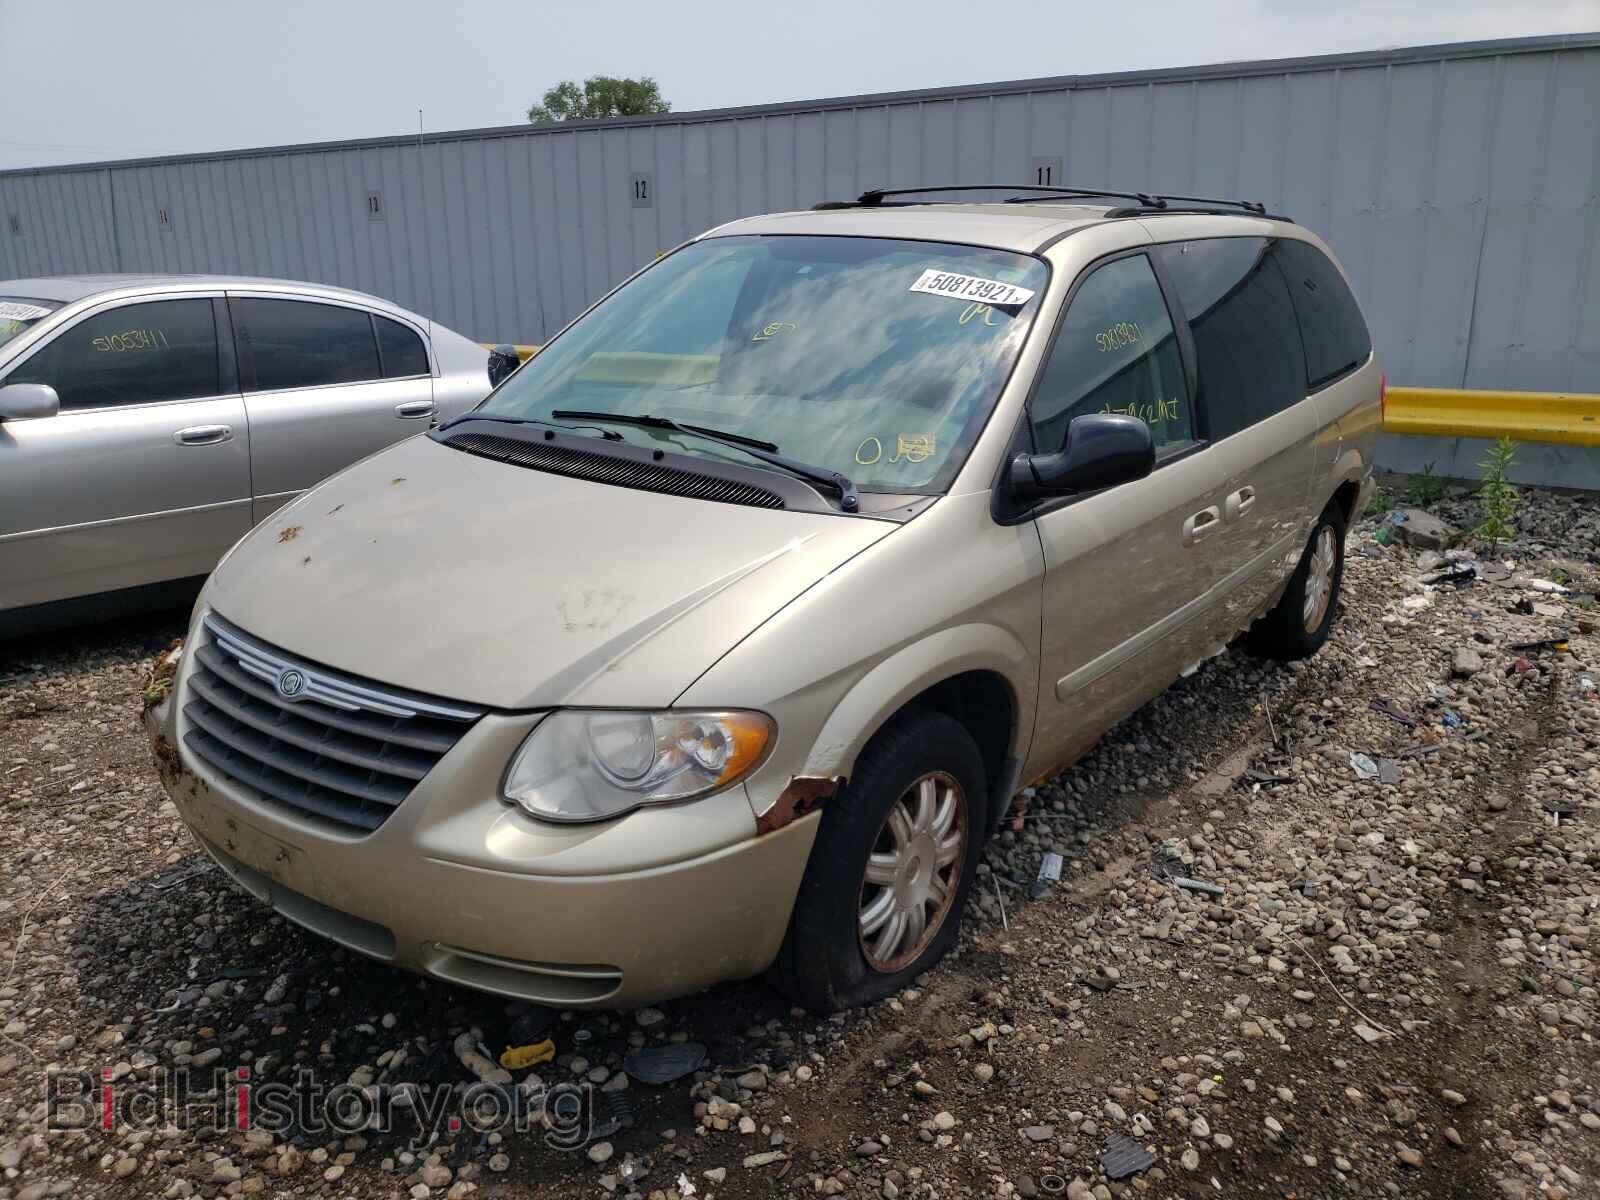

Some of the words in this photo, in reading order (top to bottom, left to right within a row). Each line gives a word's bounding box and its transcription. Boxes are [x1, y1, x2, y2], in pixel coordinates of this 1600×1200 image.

[1037, 166, 1051, 187] 11
[635, 180, 648, 200] 12
[928, 273, 1017, 303] 50813921
